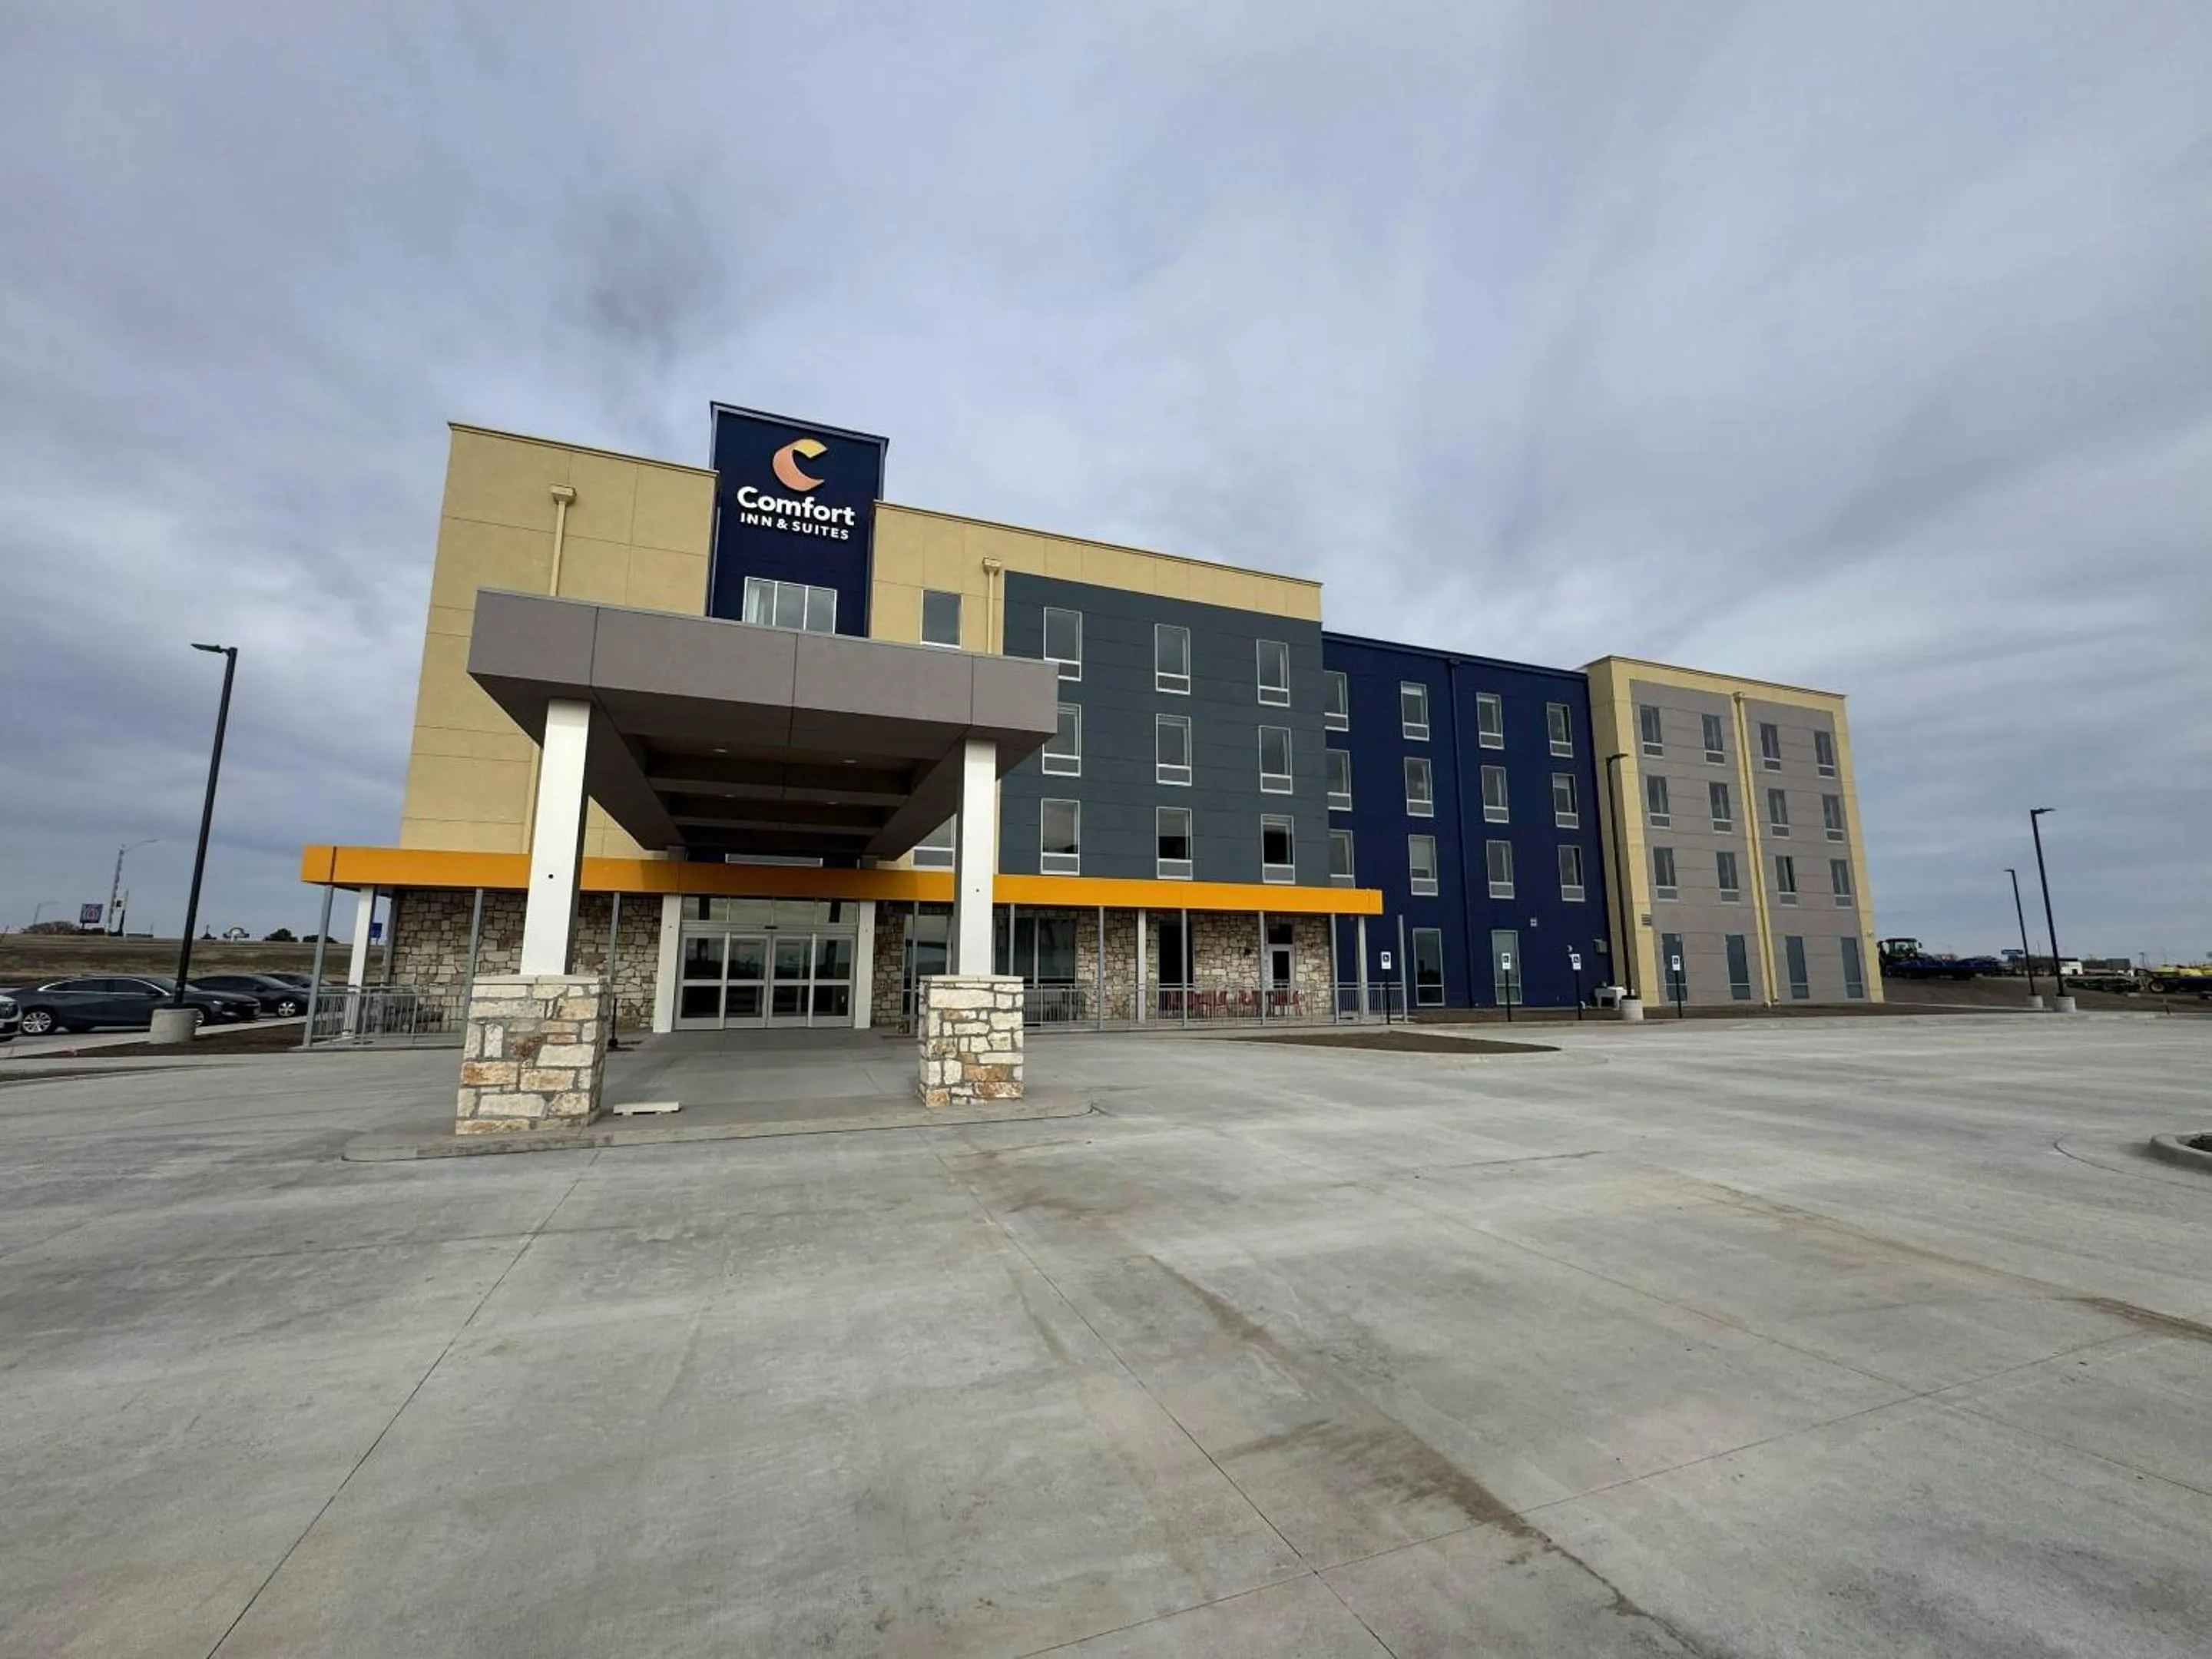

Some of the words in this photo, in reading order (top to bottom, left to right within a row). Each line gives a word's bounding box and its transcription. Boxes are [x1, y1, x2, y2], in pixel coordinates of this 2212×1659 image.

[737, 486, 856, 525] Comfort
[740, 512, 773, 527] INN
[777, 518, 788, 530] &
[792, 522, 849, 540] SUITES
